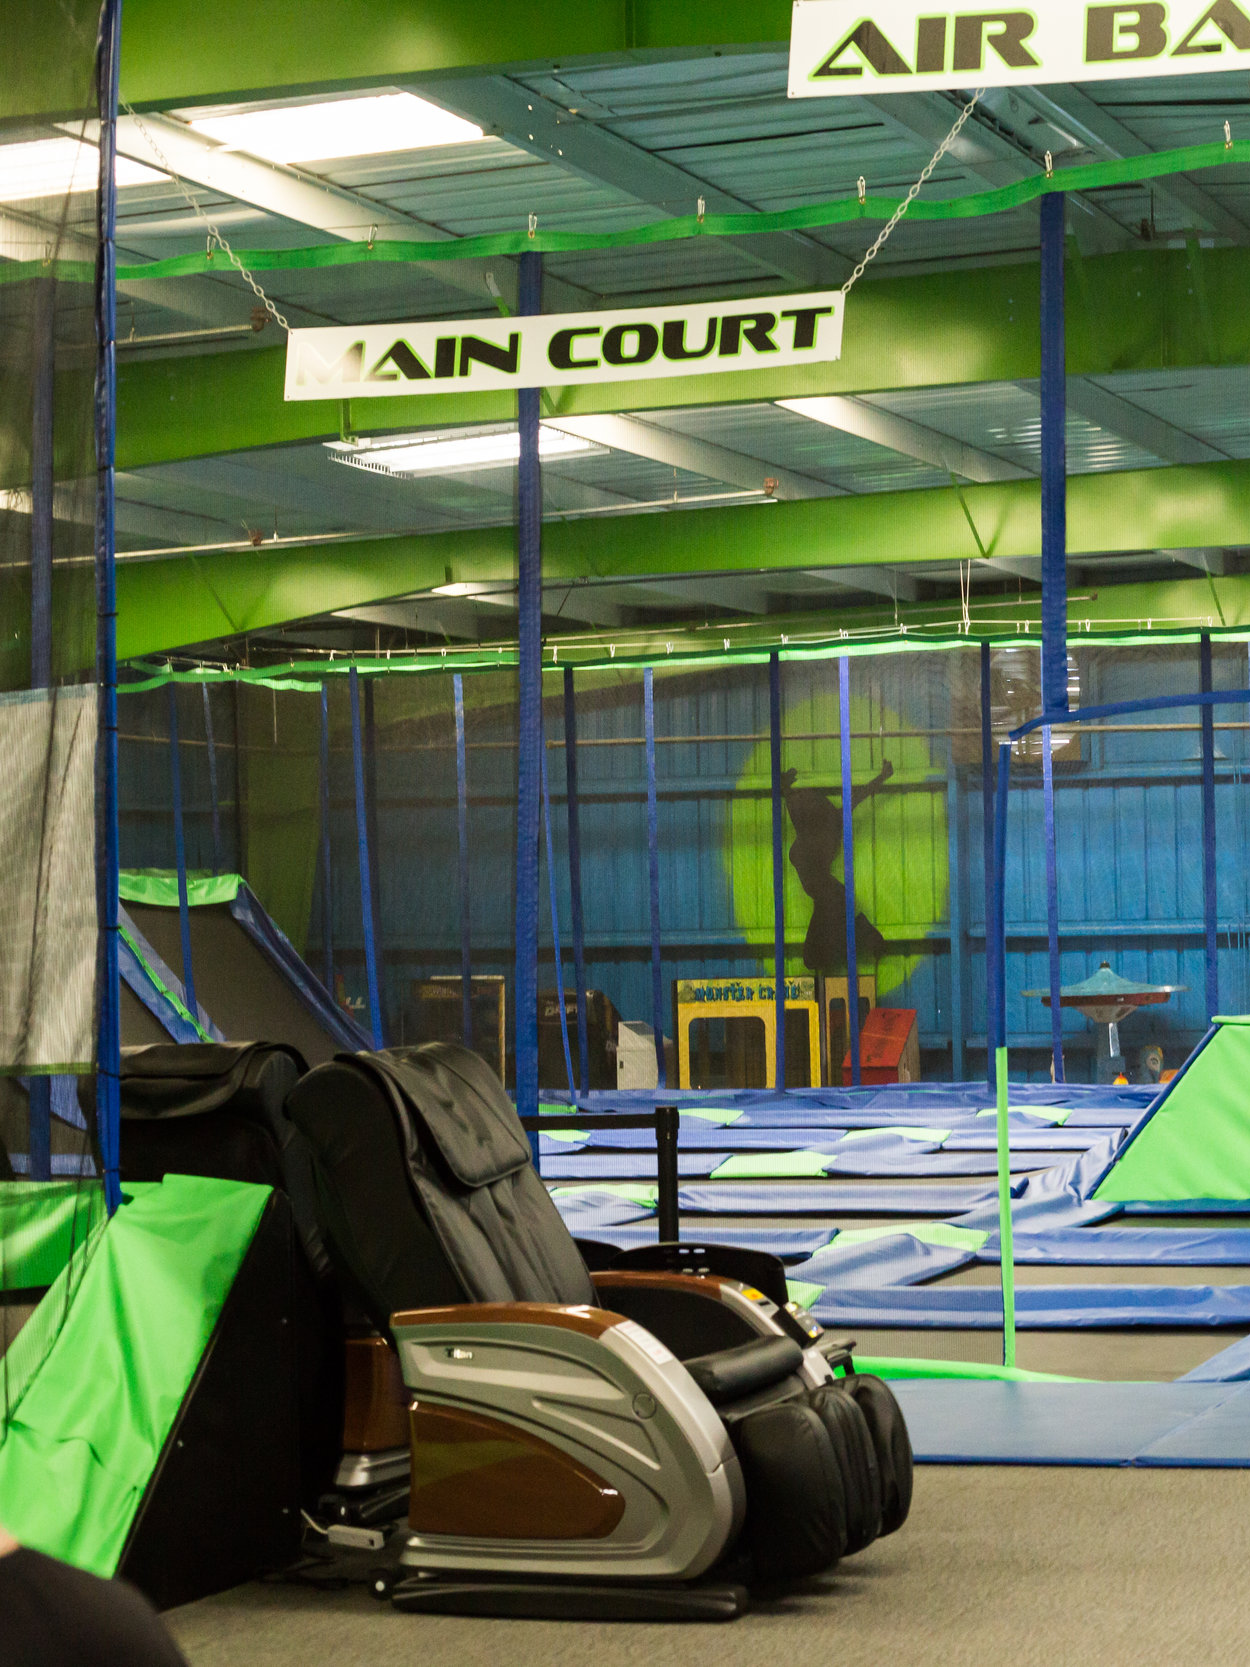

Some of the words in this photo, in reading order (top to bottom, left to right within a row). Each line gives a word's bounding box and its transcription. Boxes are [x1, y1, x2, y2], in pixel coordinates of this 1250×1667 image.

[807, 11, 1043, 81] AIR
[296, 331, 522, 386] MAIN
[547, 306, 835, 370] COURT
[696, 985, 754, 1001] MONSTER
[759, 985, 799, 1000] CRNE
